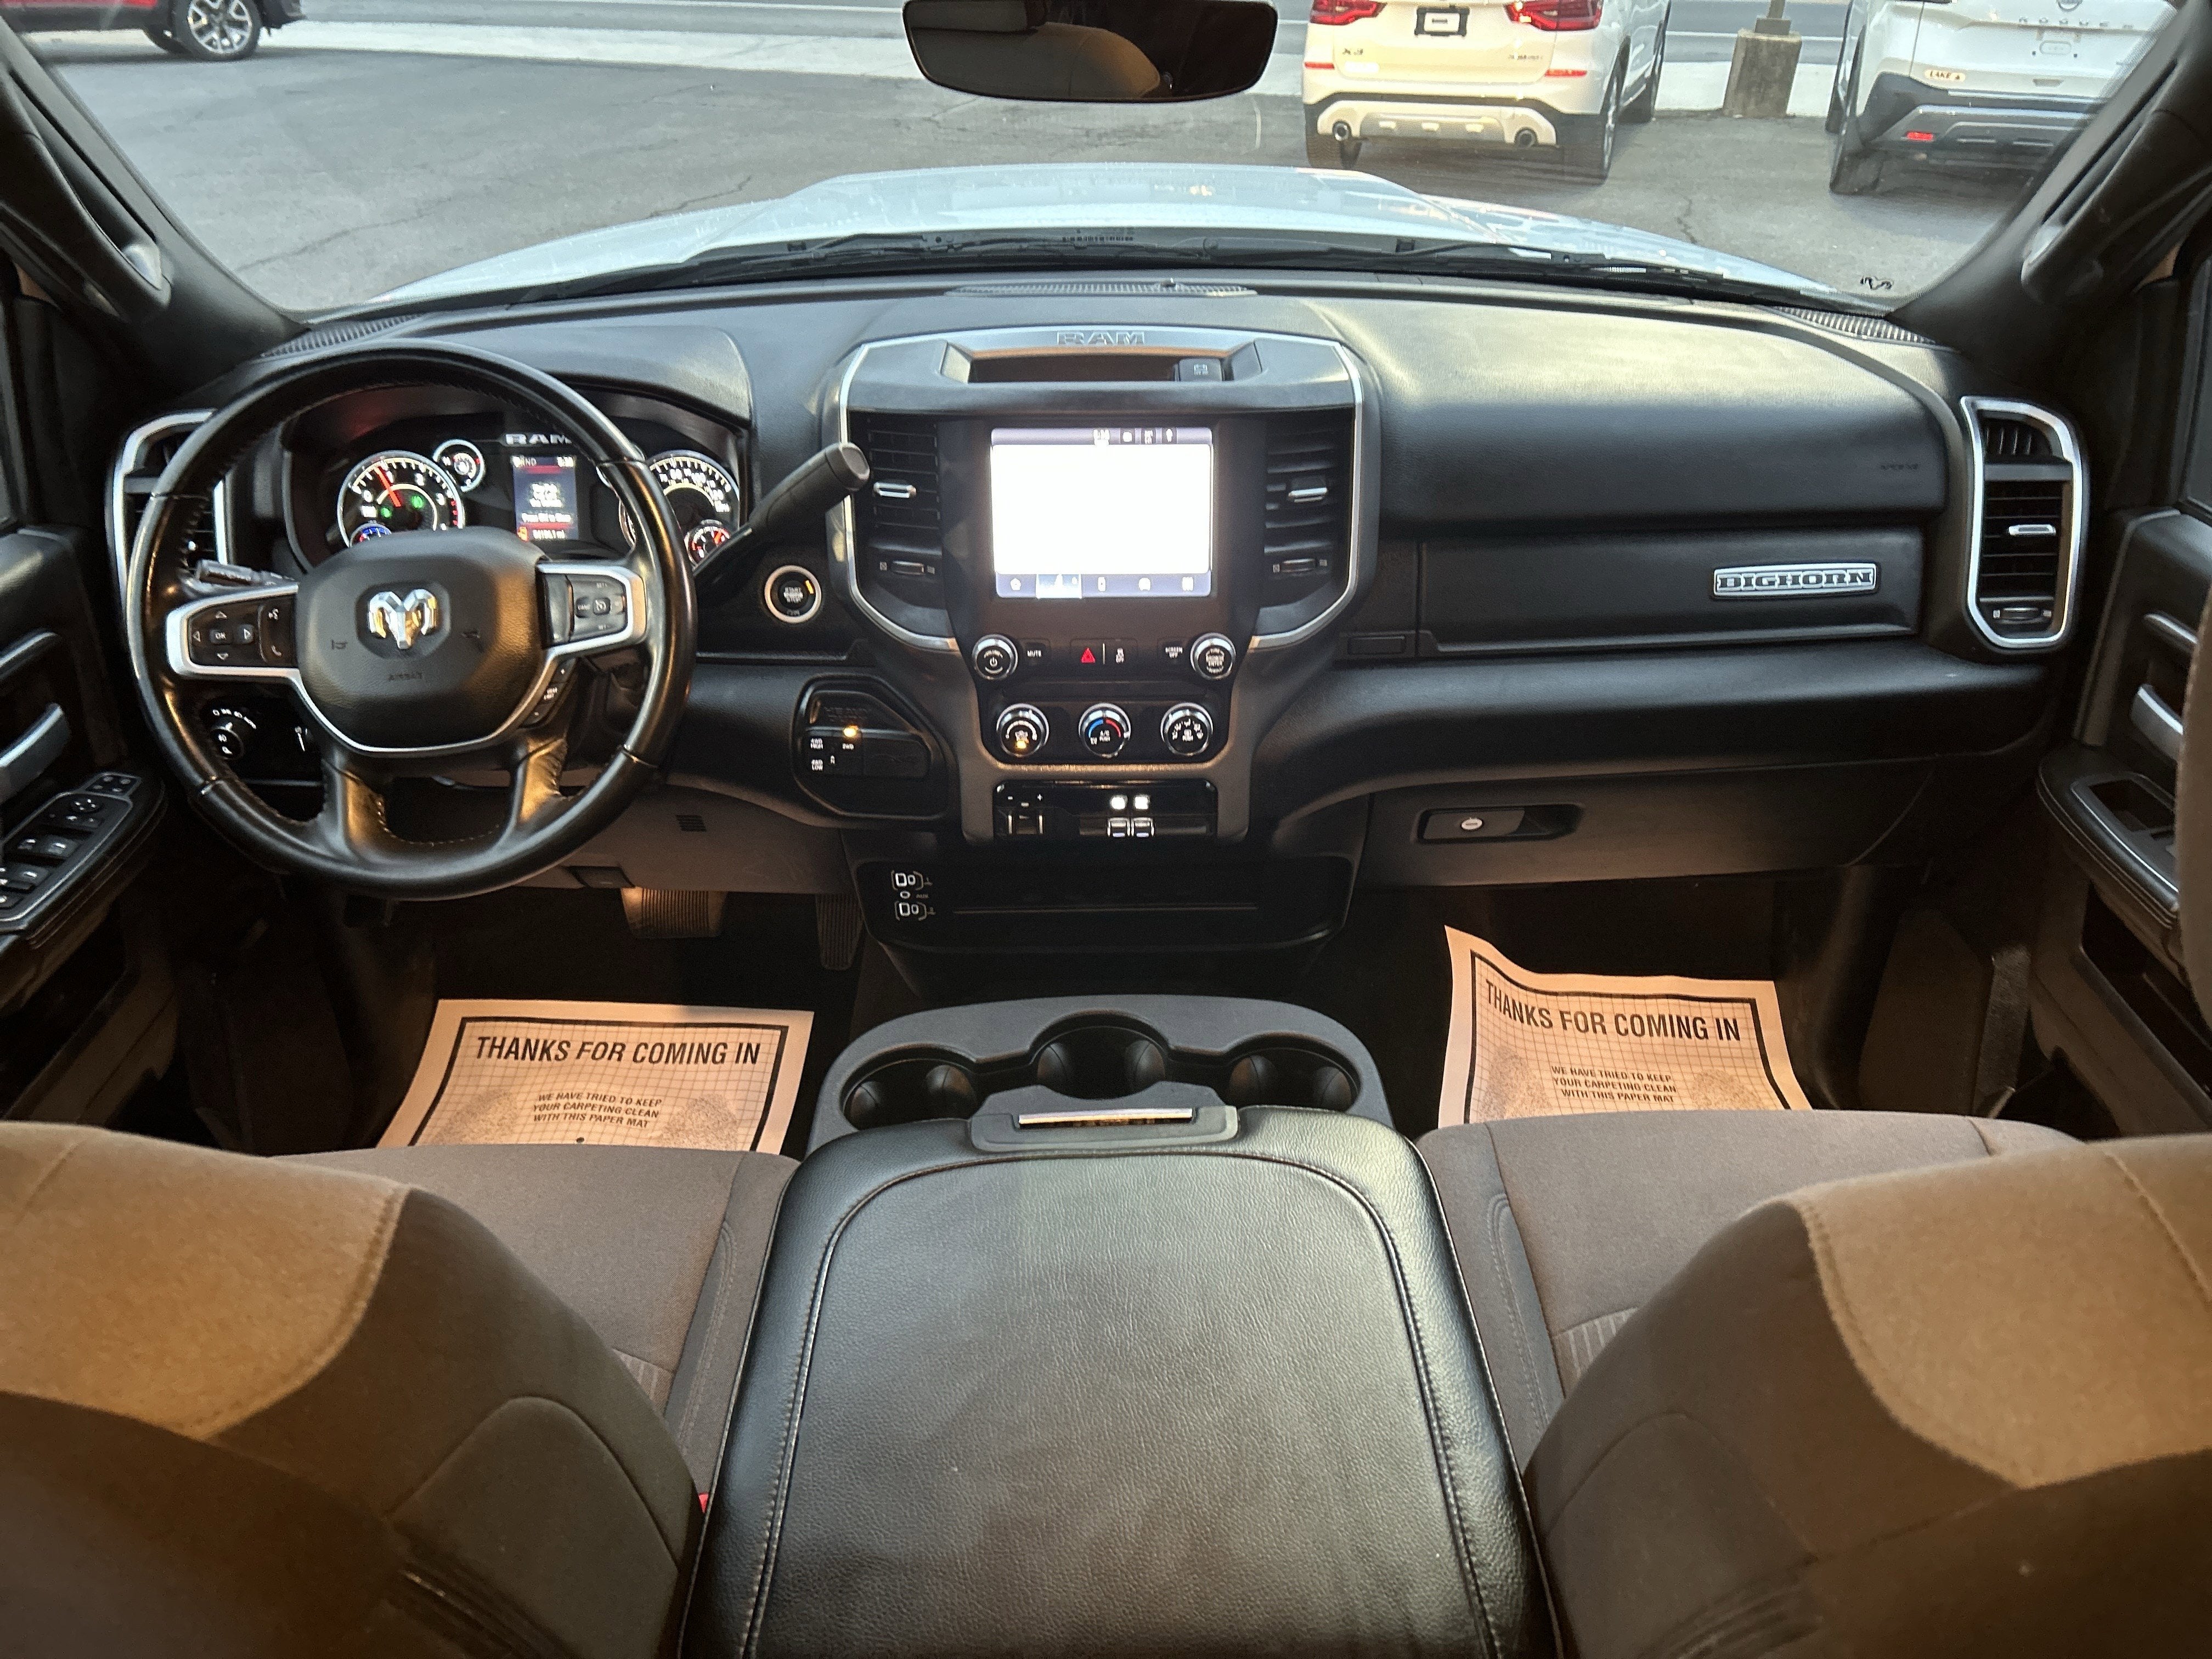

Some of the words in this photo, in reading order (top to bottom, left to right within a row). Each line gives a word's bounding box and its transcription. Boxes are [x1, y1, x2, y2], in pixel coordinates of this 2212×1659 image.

[1057, 331, 1145, 346] RAM
[505, 433, 572, 445] RAM
[1486, 979, 1553, 1029] THANKS
[1559, 1010, 1607, 1035] FOR
[1615, 1013, 1708, 1040] COMING
[1716, 1018, 1740, 1041] IN
[477, 1036, 571, 1062] THANKS
[576, 1041, 627, 1062] FOR
[633, 1042, 728, 1065] COMING
[735, 1042, 761, 1065] IN
[1551, 1065, 1567, 1075] WE
[1570, 1067, 1596, 1077] HAVE
[1599, 1070, 1628, 1080] TRIED
[1630, 1071, 1644, 1081] TO
[1647, 1073, 1671, 1082] KEEP
[1553, 1077, 1582, 1087] YOUR
[1585, 1079, 1641, 1091] CARPETING
[1644, 1084, 1677, 1093] CLEAN
[538, 1093, 554, 1102] WE
[556, 1092, 584, 1101] HAVE
[586, 1092, 616, 1103] TRIED
[620, 1097, 633, 1105] TO
[635, 1098, 662, 1107] KEEP
[1561, 1088, 1588, 1098] WITH
[1592, 1091, 1615, 1100] THIS
[1617, 1092, 1651, 1102] PAPER
[533, 1102, 561, 1111] YOUR
[563, 1102, 622, 1114] CARPETING
[625, 1107, 659, 1118] CLEAN
[534, 1113, 560, 1122] WITH
[563, 1113, 586, 1121] THIS
[589, 1114, 624, 1125] PAPER
[627, 1118, 649, 1128] MAT
